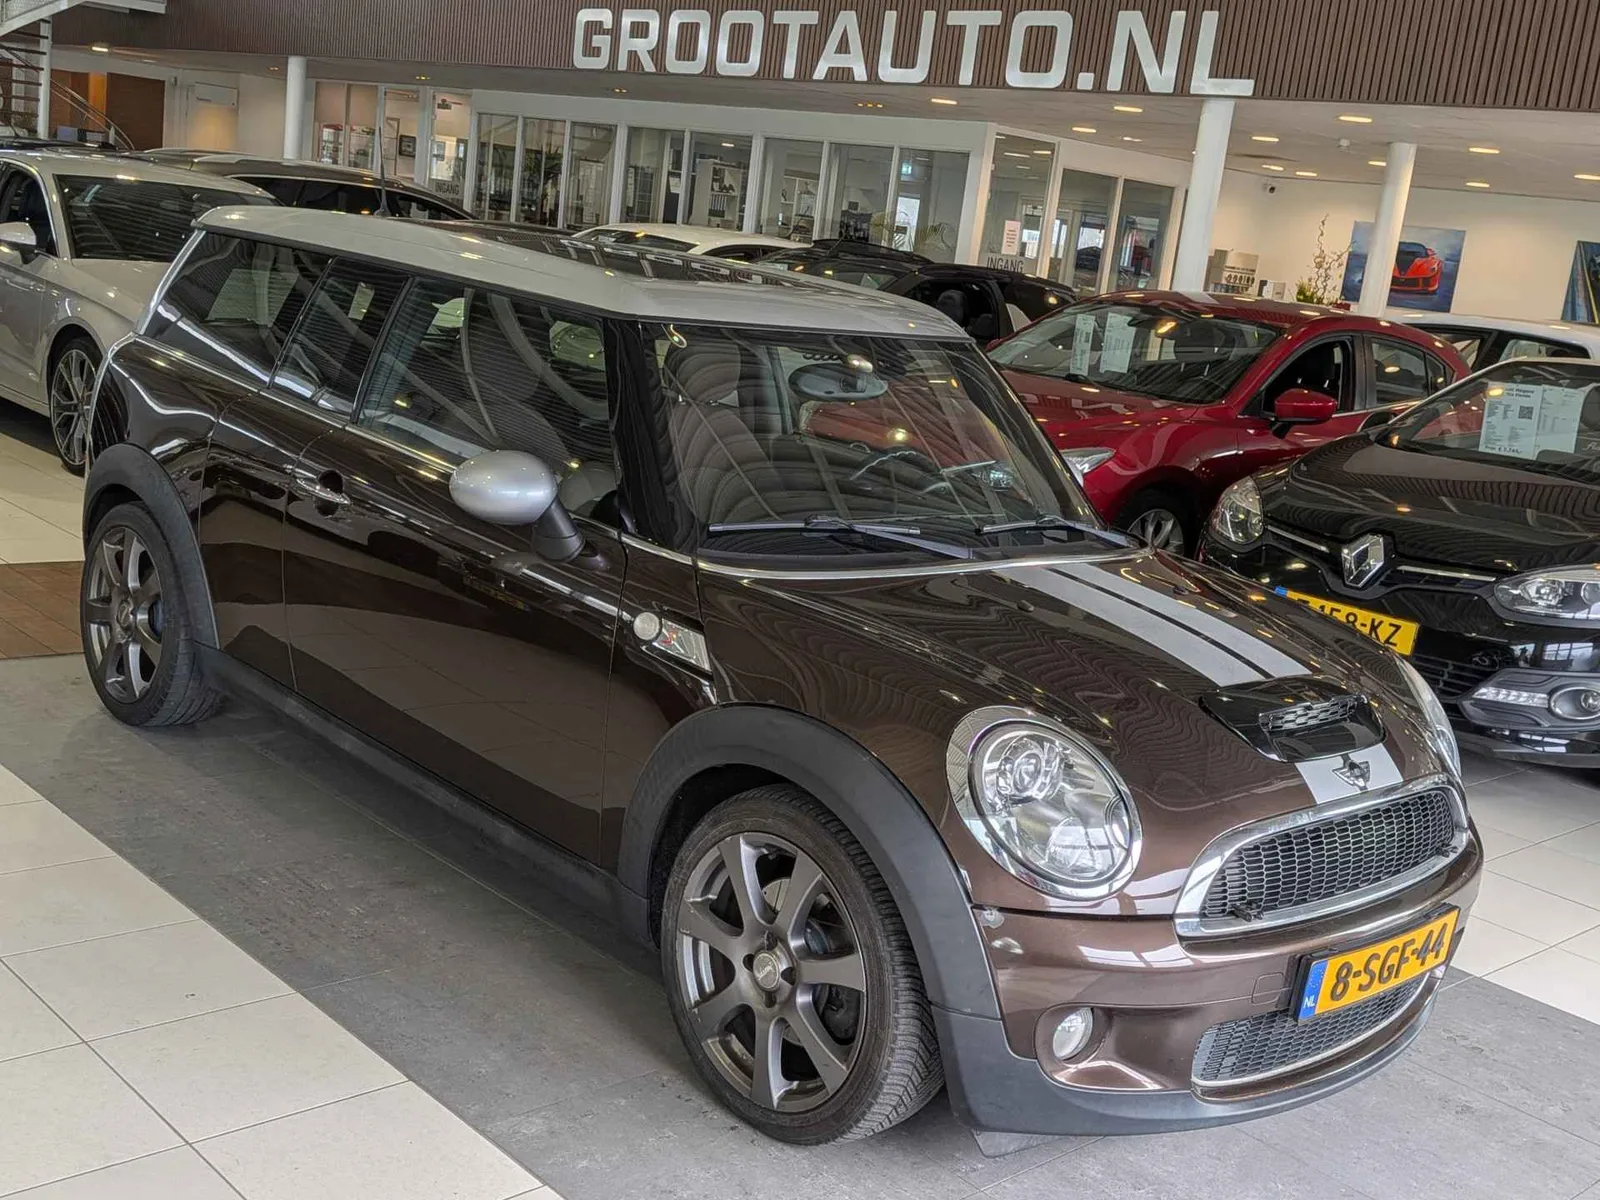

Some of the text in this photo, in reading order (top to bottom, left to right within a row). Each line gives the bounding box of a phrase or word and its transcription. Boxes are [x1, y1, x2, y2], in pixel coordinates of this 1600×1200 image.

[572, 8, 1255, 95] GROOTAUTO.NL
[986, 256, 1024, 273] INGANG
[1330, 922, 1448, 1001] 8-SGF-44
[1303, 995, 1316, 1007] NL
